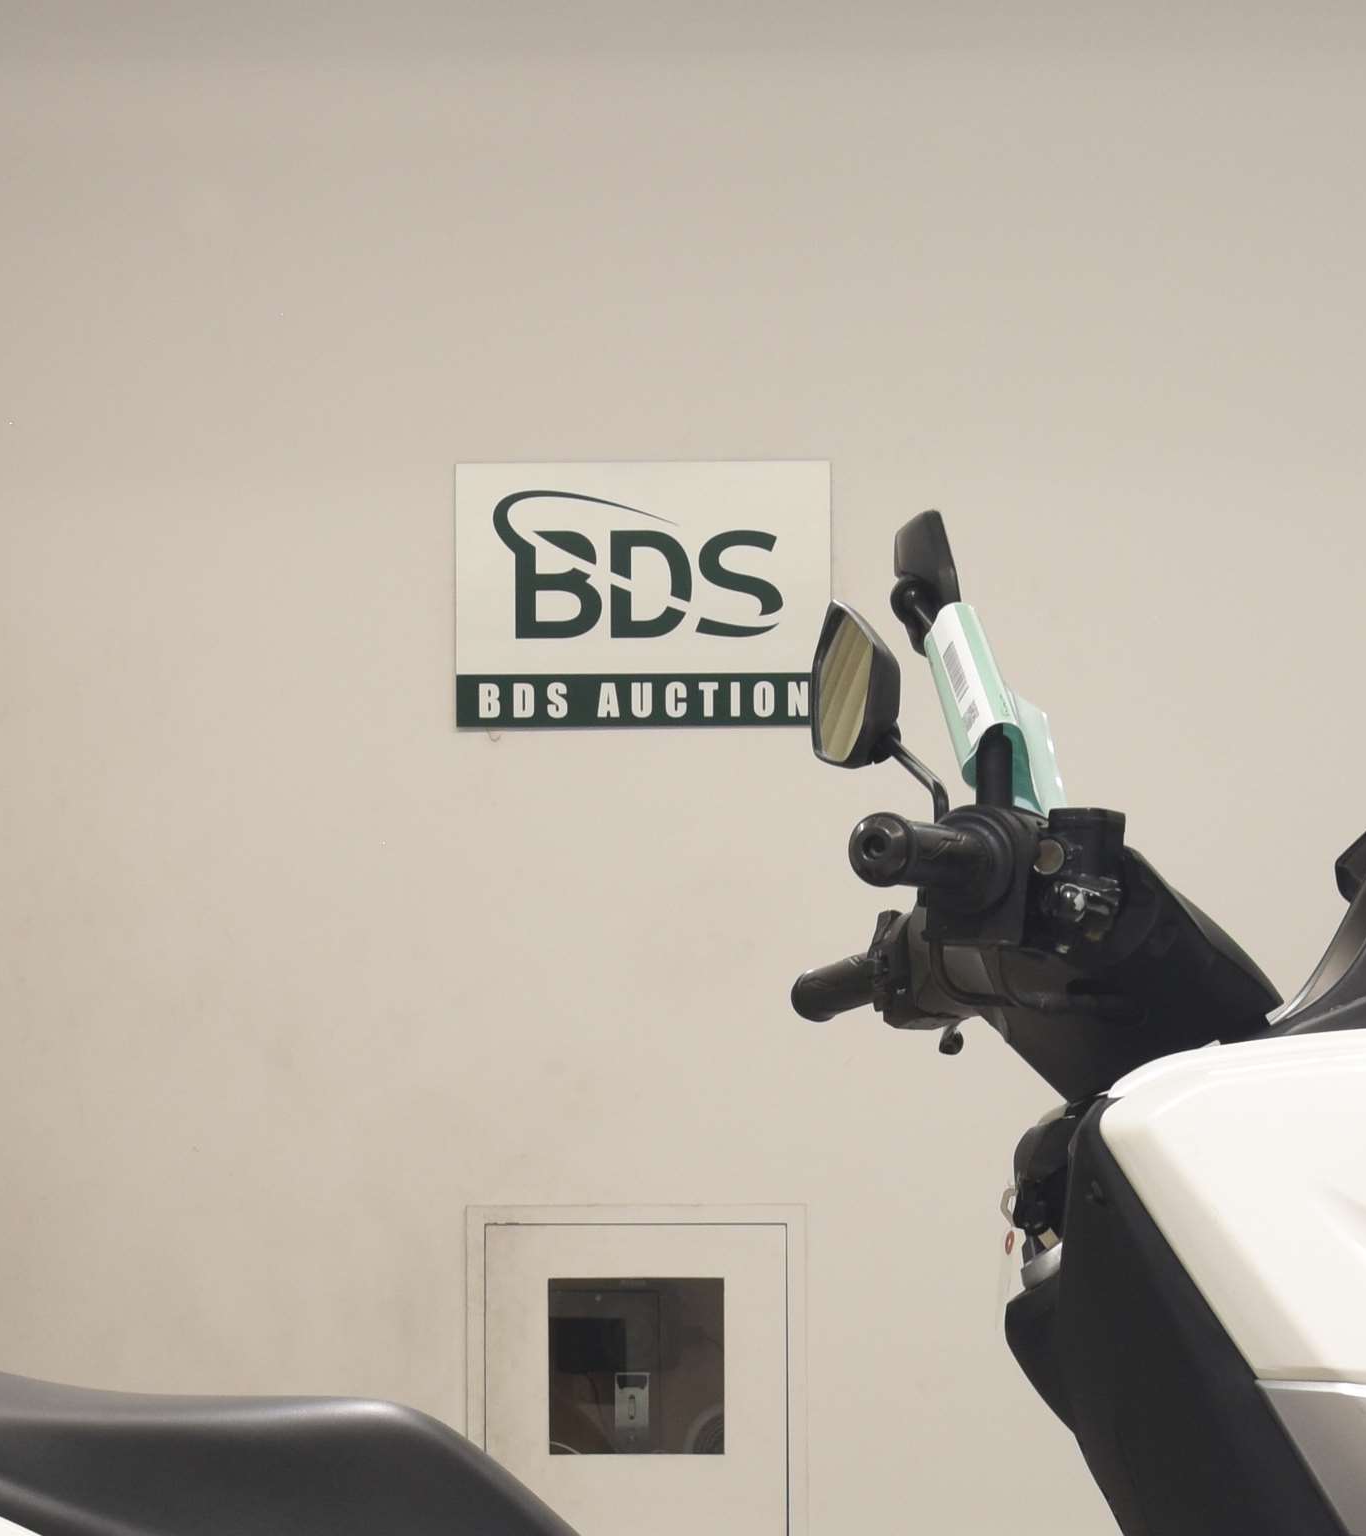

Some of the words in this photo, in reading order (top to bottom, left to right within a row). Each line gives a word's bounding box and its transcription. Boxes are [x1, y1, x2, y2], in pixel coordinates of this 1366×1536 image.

[493, 490, 783, 639] BDS
[478, 682, 568, 719] BDS
[596, 680, 810, 719] AUCTION
